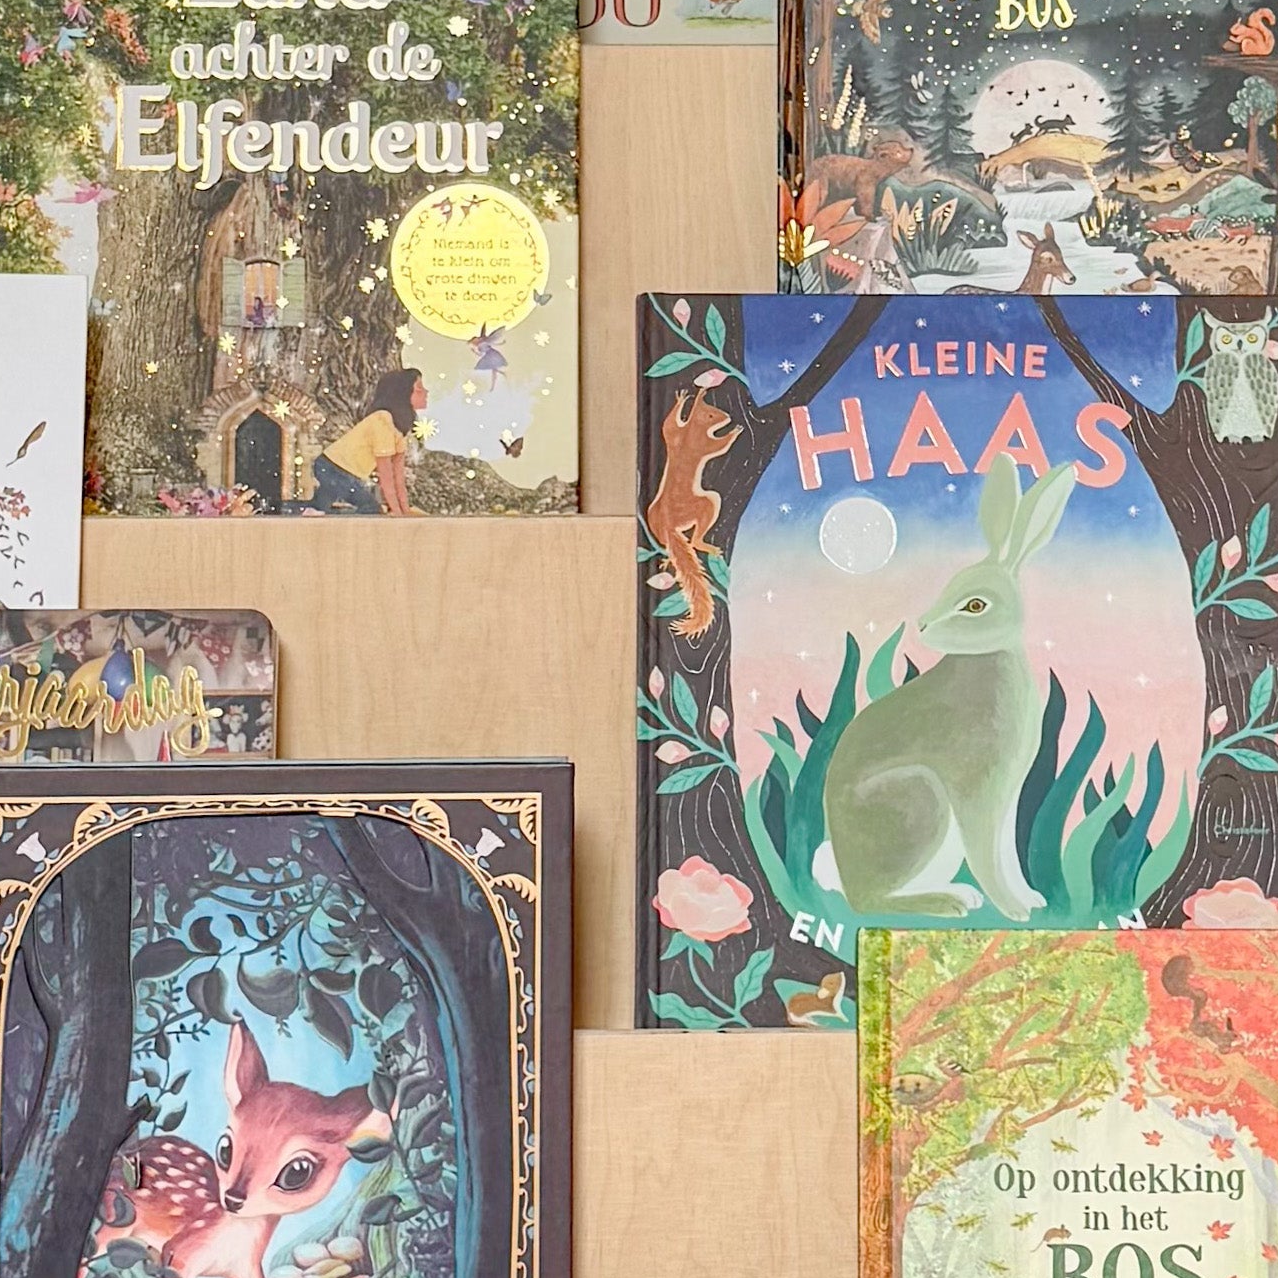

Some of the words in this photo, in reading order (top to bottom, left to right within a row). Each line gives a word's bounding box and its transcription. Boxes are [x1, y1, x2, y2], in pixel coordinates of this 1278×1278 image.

[170, 19, 350, 82] achter
[367, 22, 442, 82] de
[115, 83, 504, 191] Elfendeur
[433, 239, 494, 249] Niemand
[449, 256, 484, 267] klein
[463, 290, 497, 302] doen
[874, 340, 1049, 380] KLEINE
[789, 390, 1134, 490] HAAS
[789, 910, 844, 952] EN
[993, 1162, 1036, 1198] Op
[1053, 1163, 1246, 1200] ontdekking
[1083, 1205, 1109, 1230] in
[1120, 1205, 1168, 1231] het
